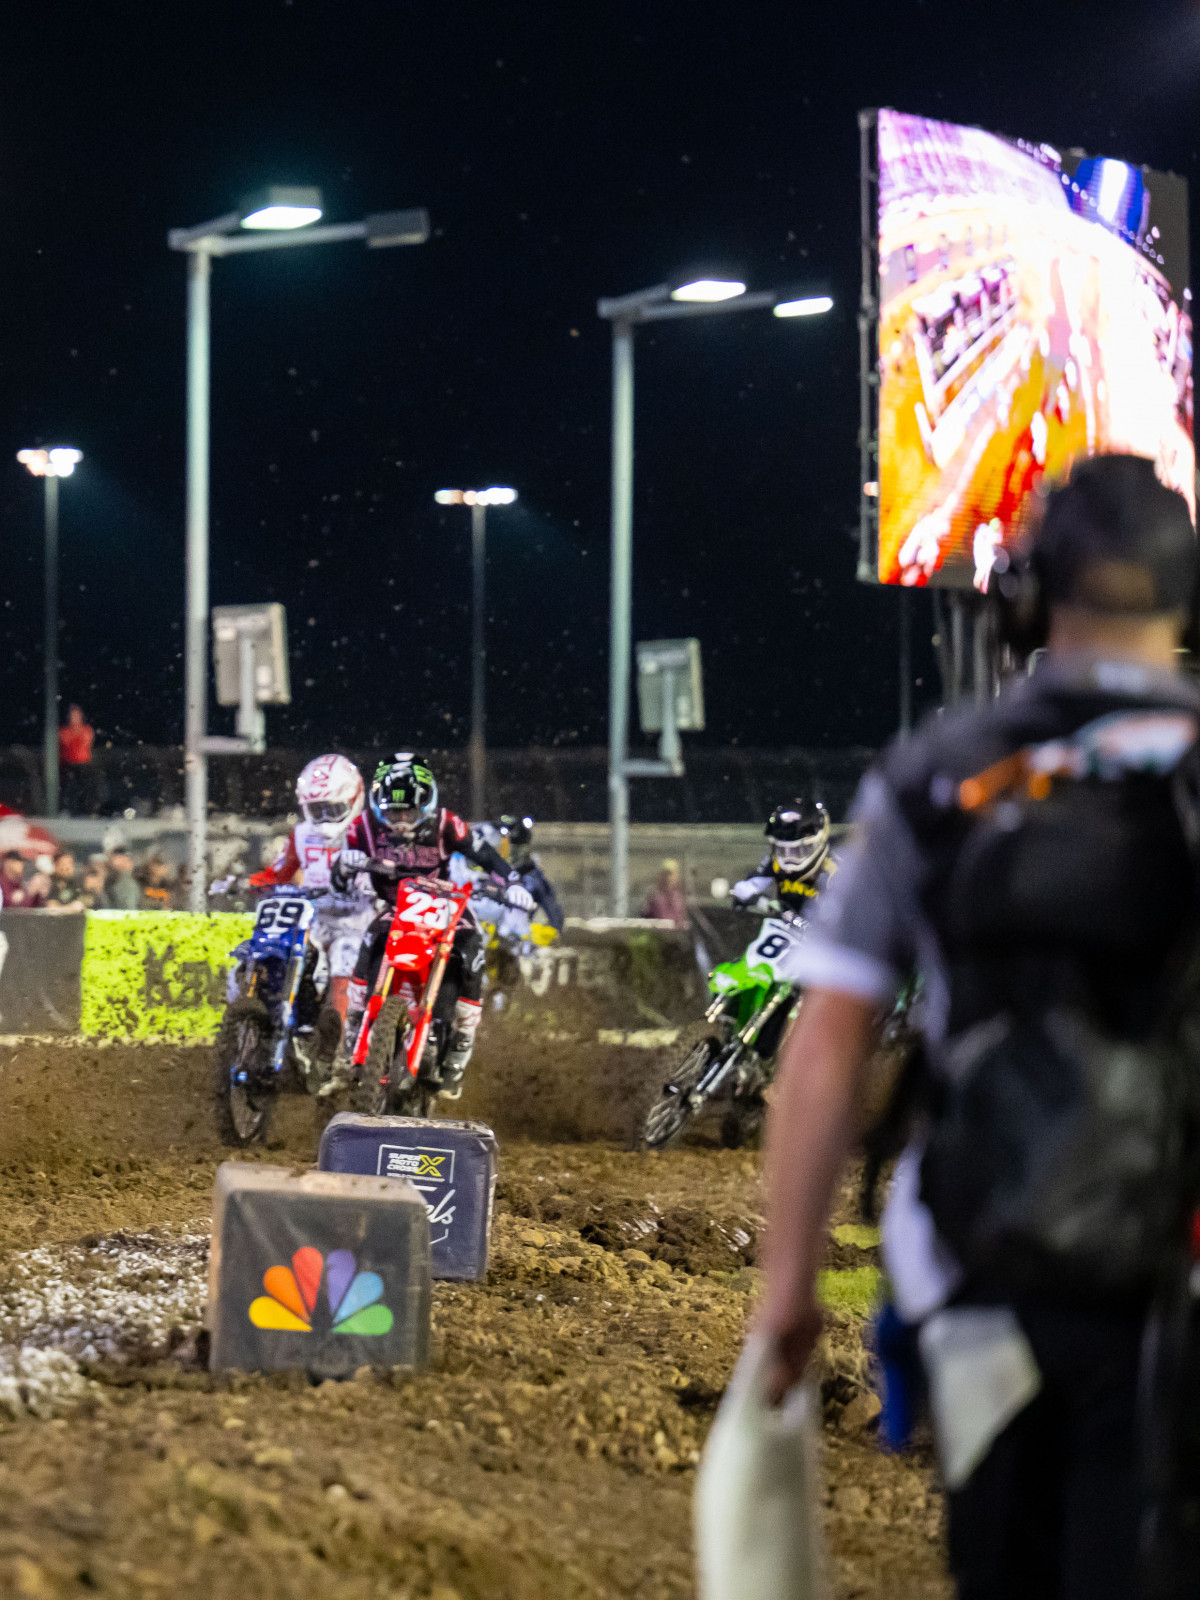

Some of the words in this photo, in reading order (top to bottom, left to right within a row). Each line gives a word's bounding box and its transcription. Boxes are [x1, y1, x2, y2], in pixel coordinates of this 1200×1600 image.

[258, 901, 304, 928] 69
[399, 892, 458, 930] 23
[388, 1152, 421, 1161] SUPER
[389, 1158, 420, 1167] MOTO
